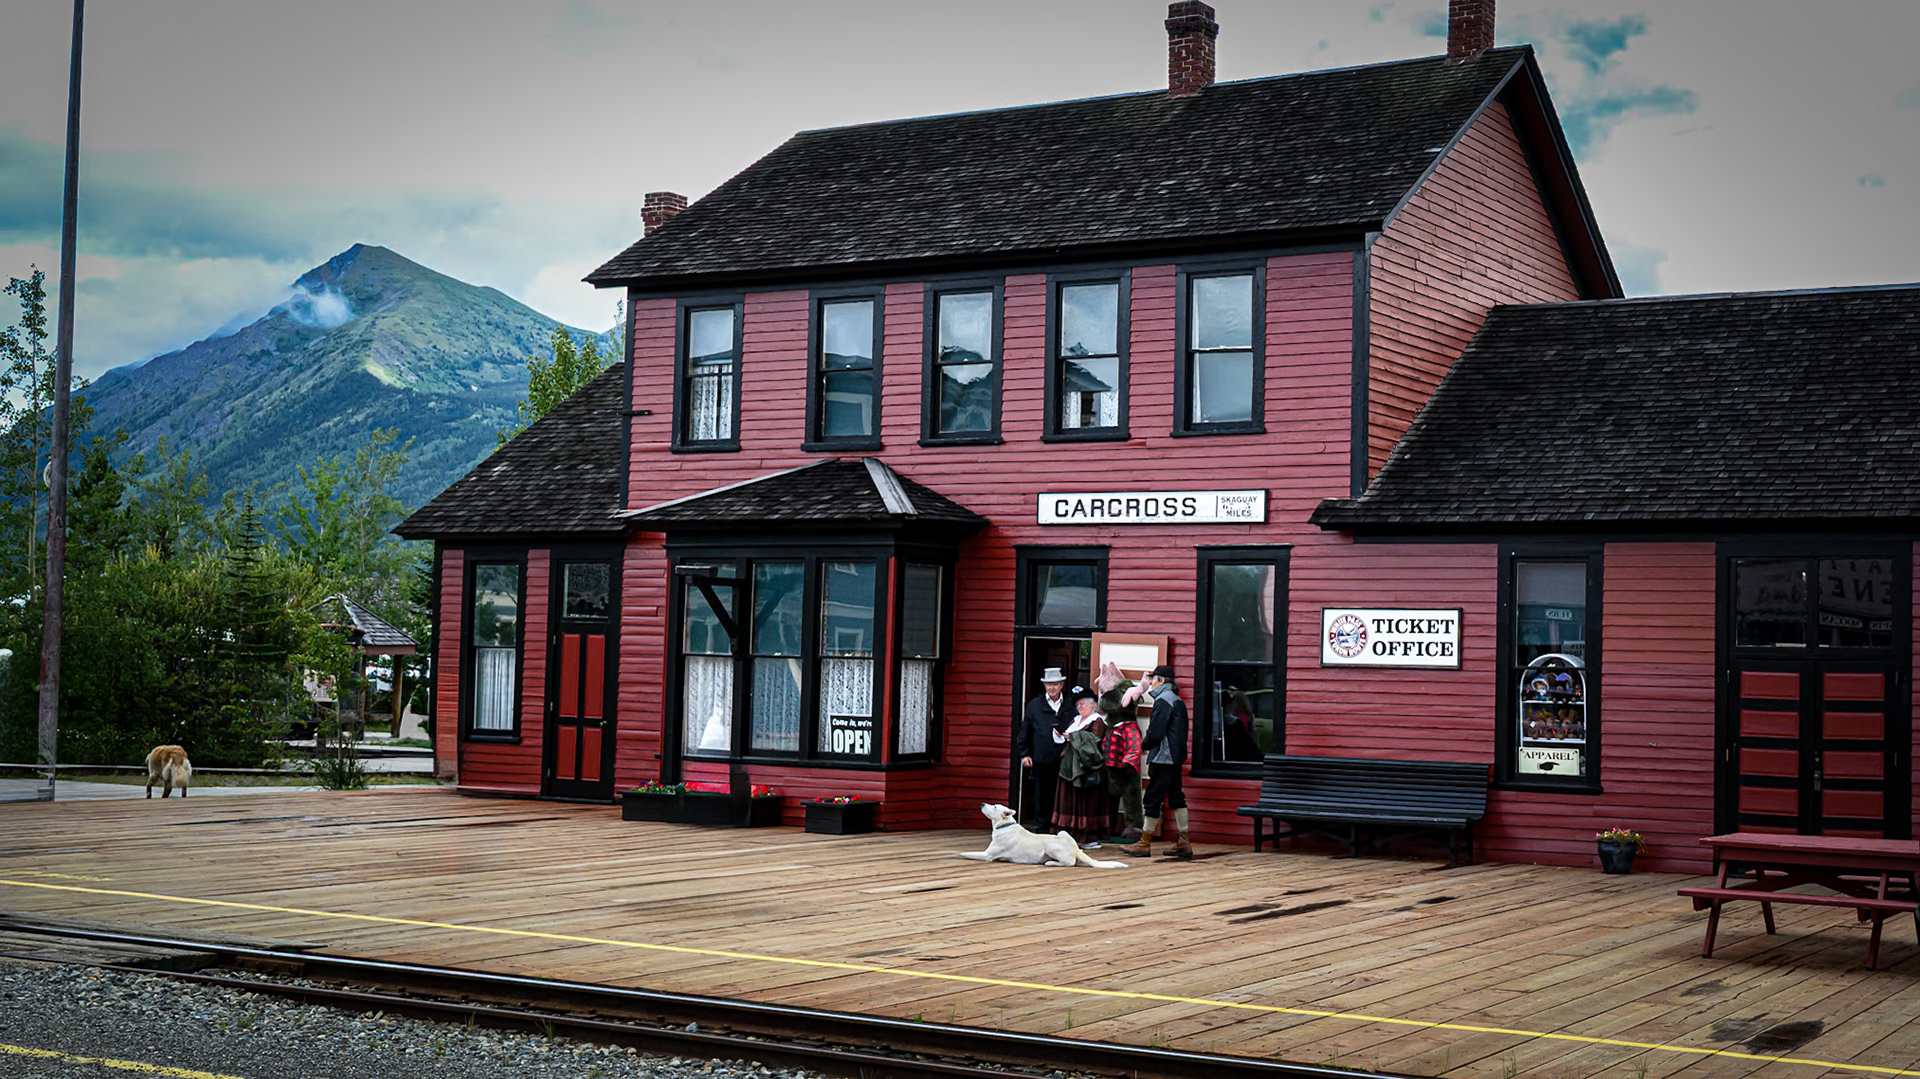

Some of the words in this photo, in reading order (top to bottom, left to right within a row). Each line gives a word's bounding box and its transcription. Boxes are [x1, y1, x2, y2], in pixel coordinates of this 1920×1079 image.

[1055, 497, 1197, 518] CARCROSS
[1372, 619, 1454, 634] TICKET
[1372, 641, 1454, 656] OFFICE
[833, 729, 871, 754] OPEN
[1524, 751, 1574, 761] APPAREL
